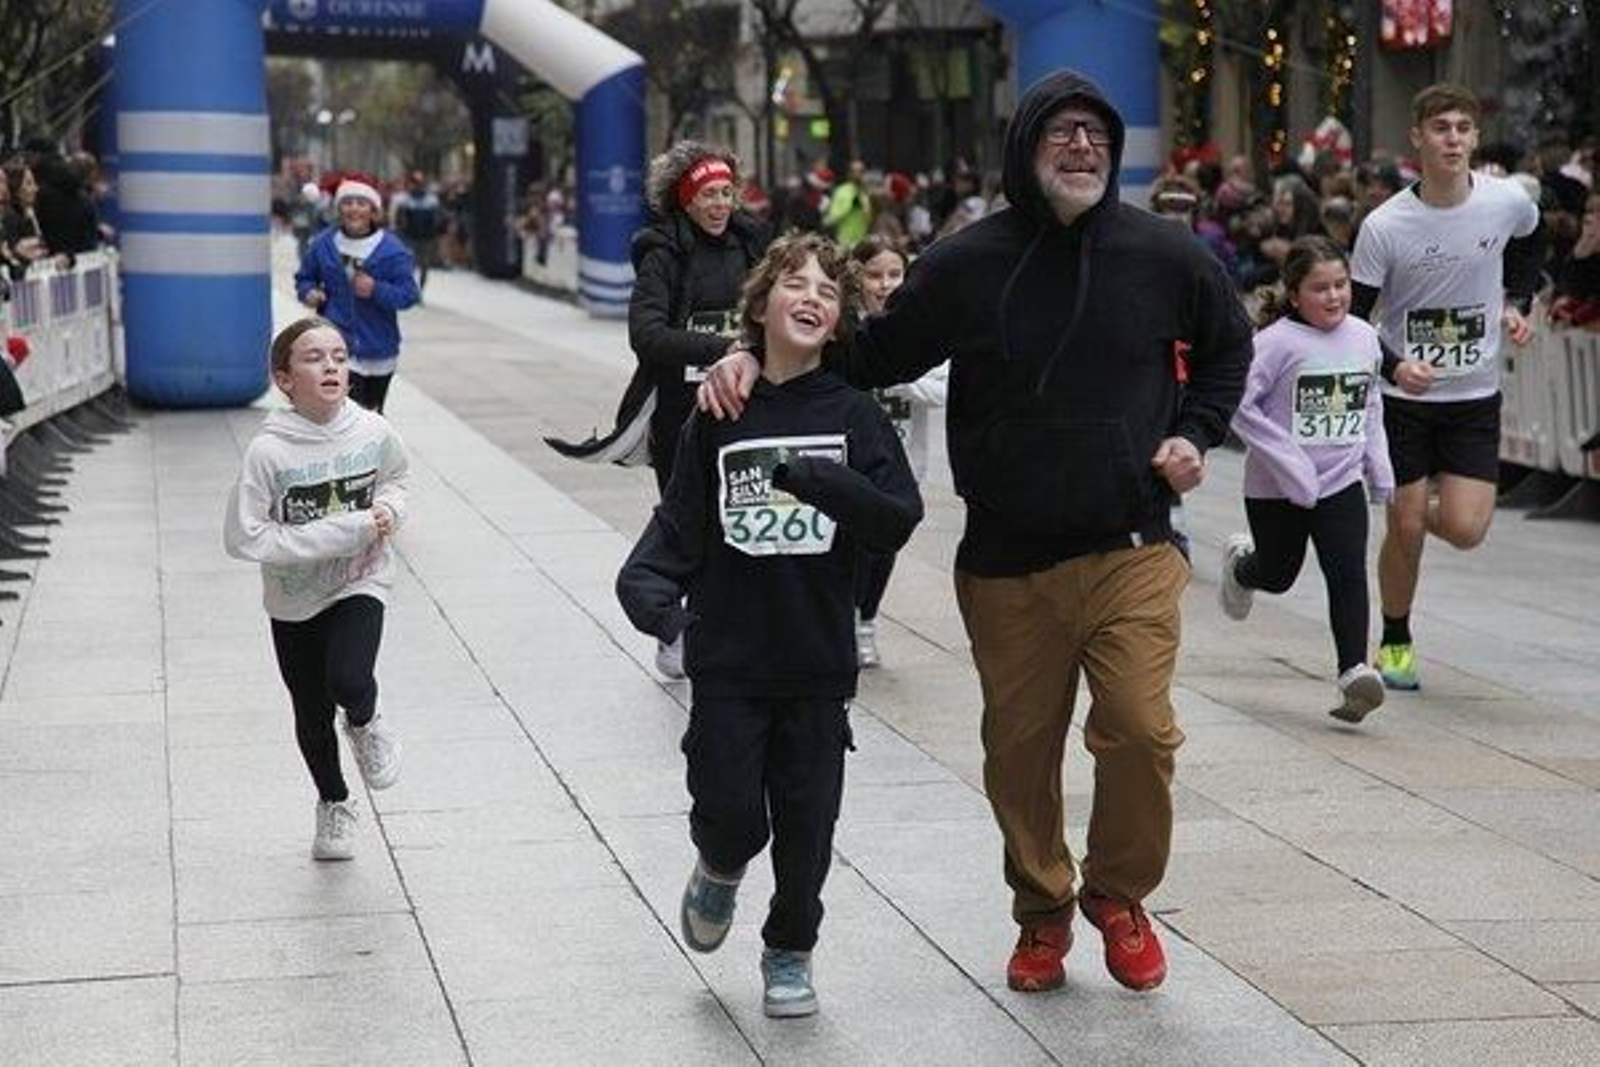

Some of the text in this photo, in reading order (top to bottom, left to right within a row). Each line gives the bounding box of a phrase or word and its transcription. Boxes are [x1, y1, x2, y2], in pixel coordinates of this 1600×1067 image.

[1411, 341, 1480, 368] 1215
[1299, 412, 1361, 438] 3172
[728, 465, 762, 486] SAN
[729, 478, 772, 498] SILVE
